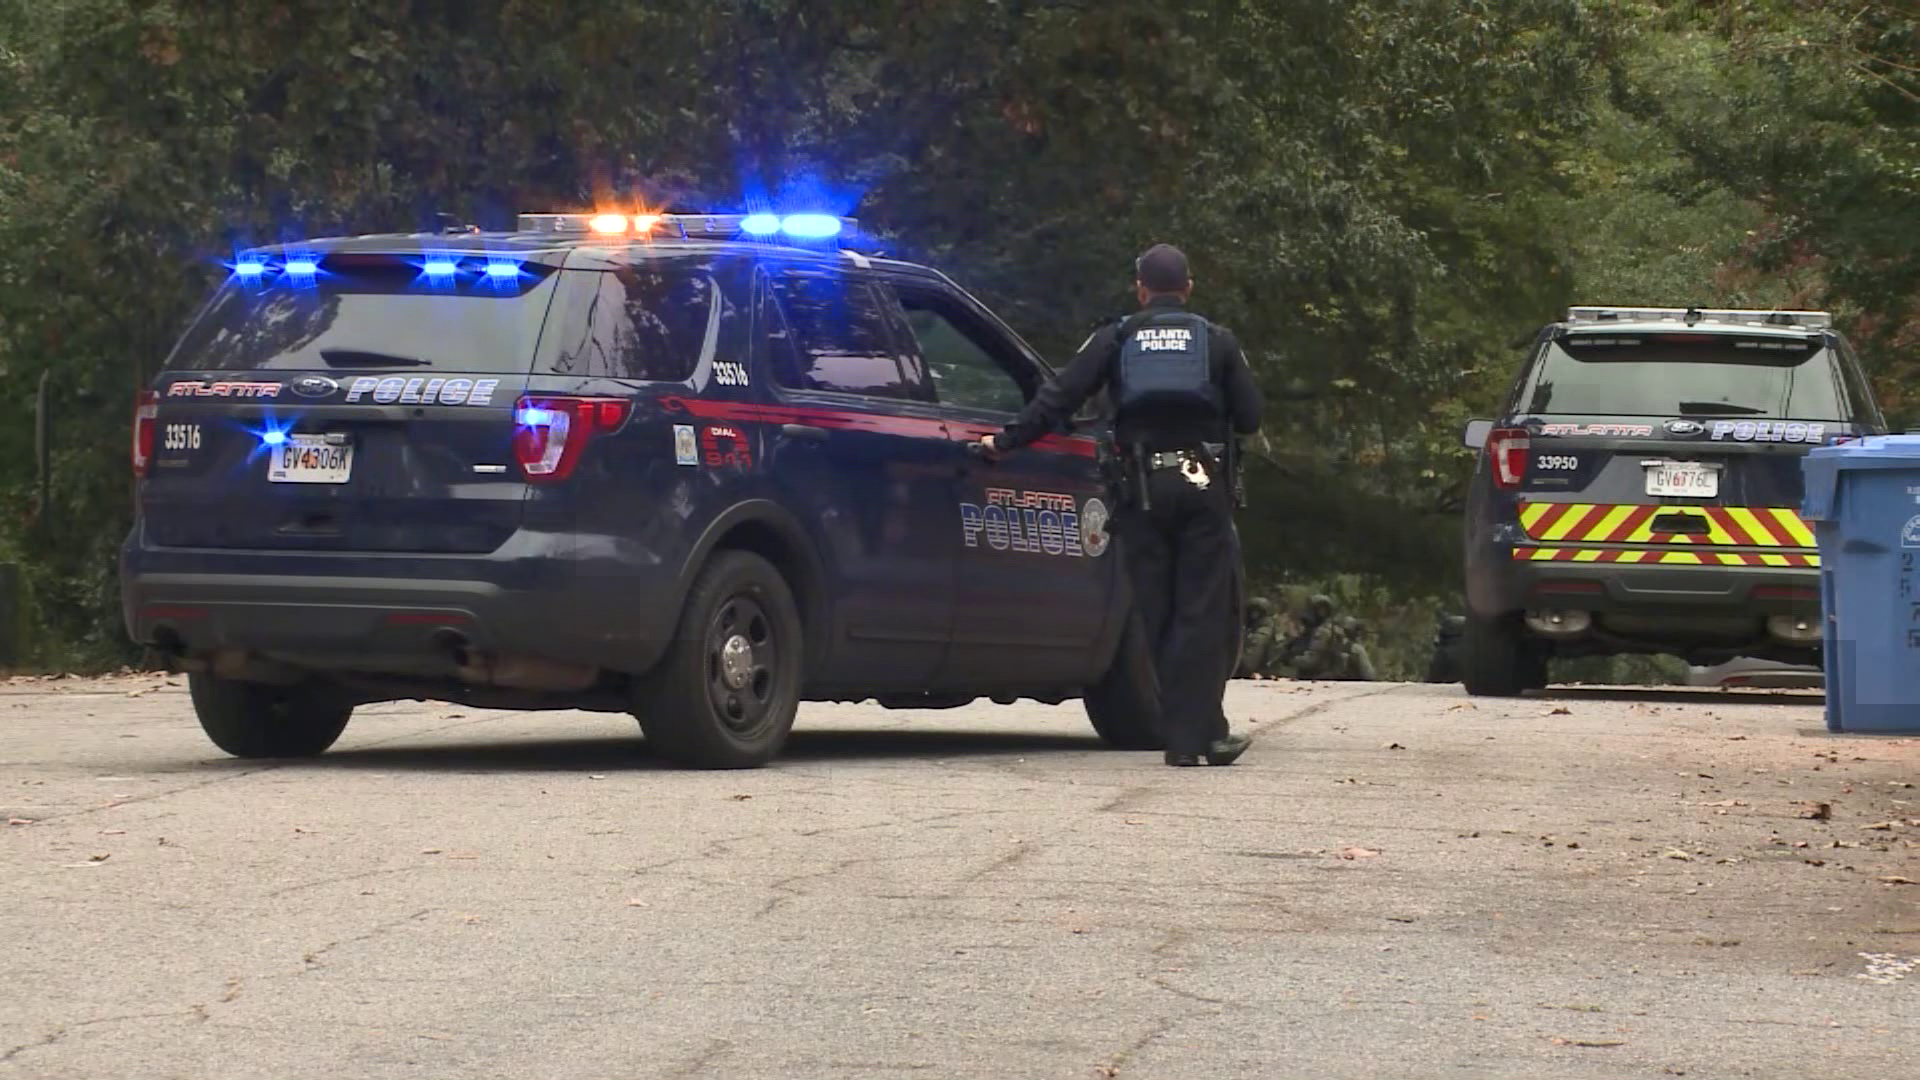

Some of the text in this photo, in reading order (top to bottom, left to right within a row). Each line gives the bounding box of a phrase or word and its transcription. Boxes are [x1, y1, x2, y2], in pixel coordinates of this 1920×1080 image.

[1135, 328, 1193, 341] ATLANTA
[1140, 339, 1187, 352] POLICE
[167, 381, 282, 398] ATLANTA
[344, 376, 500, 406] POLICE
[165, 424, 201, 450] 33516
[710, 427, 737, 438] DIAL
[1540, 423, 1654, 437] ATLANTA
[1711, 420, 1825, 444] POLICE
[1537, 455, 1578, 470] 33950
[985, 487, 1076, 512] ATLANTA
[960, 502, 1084, 557] POLICE
